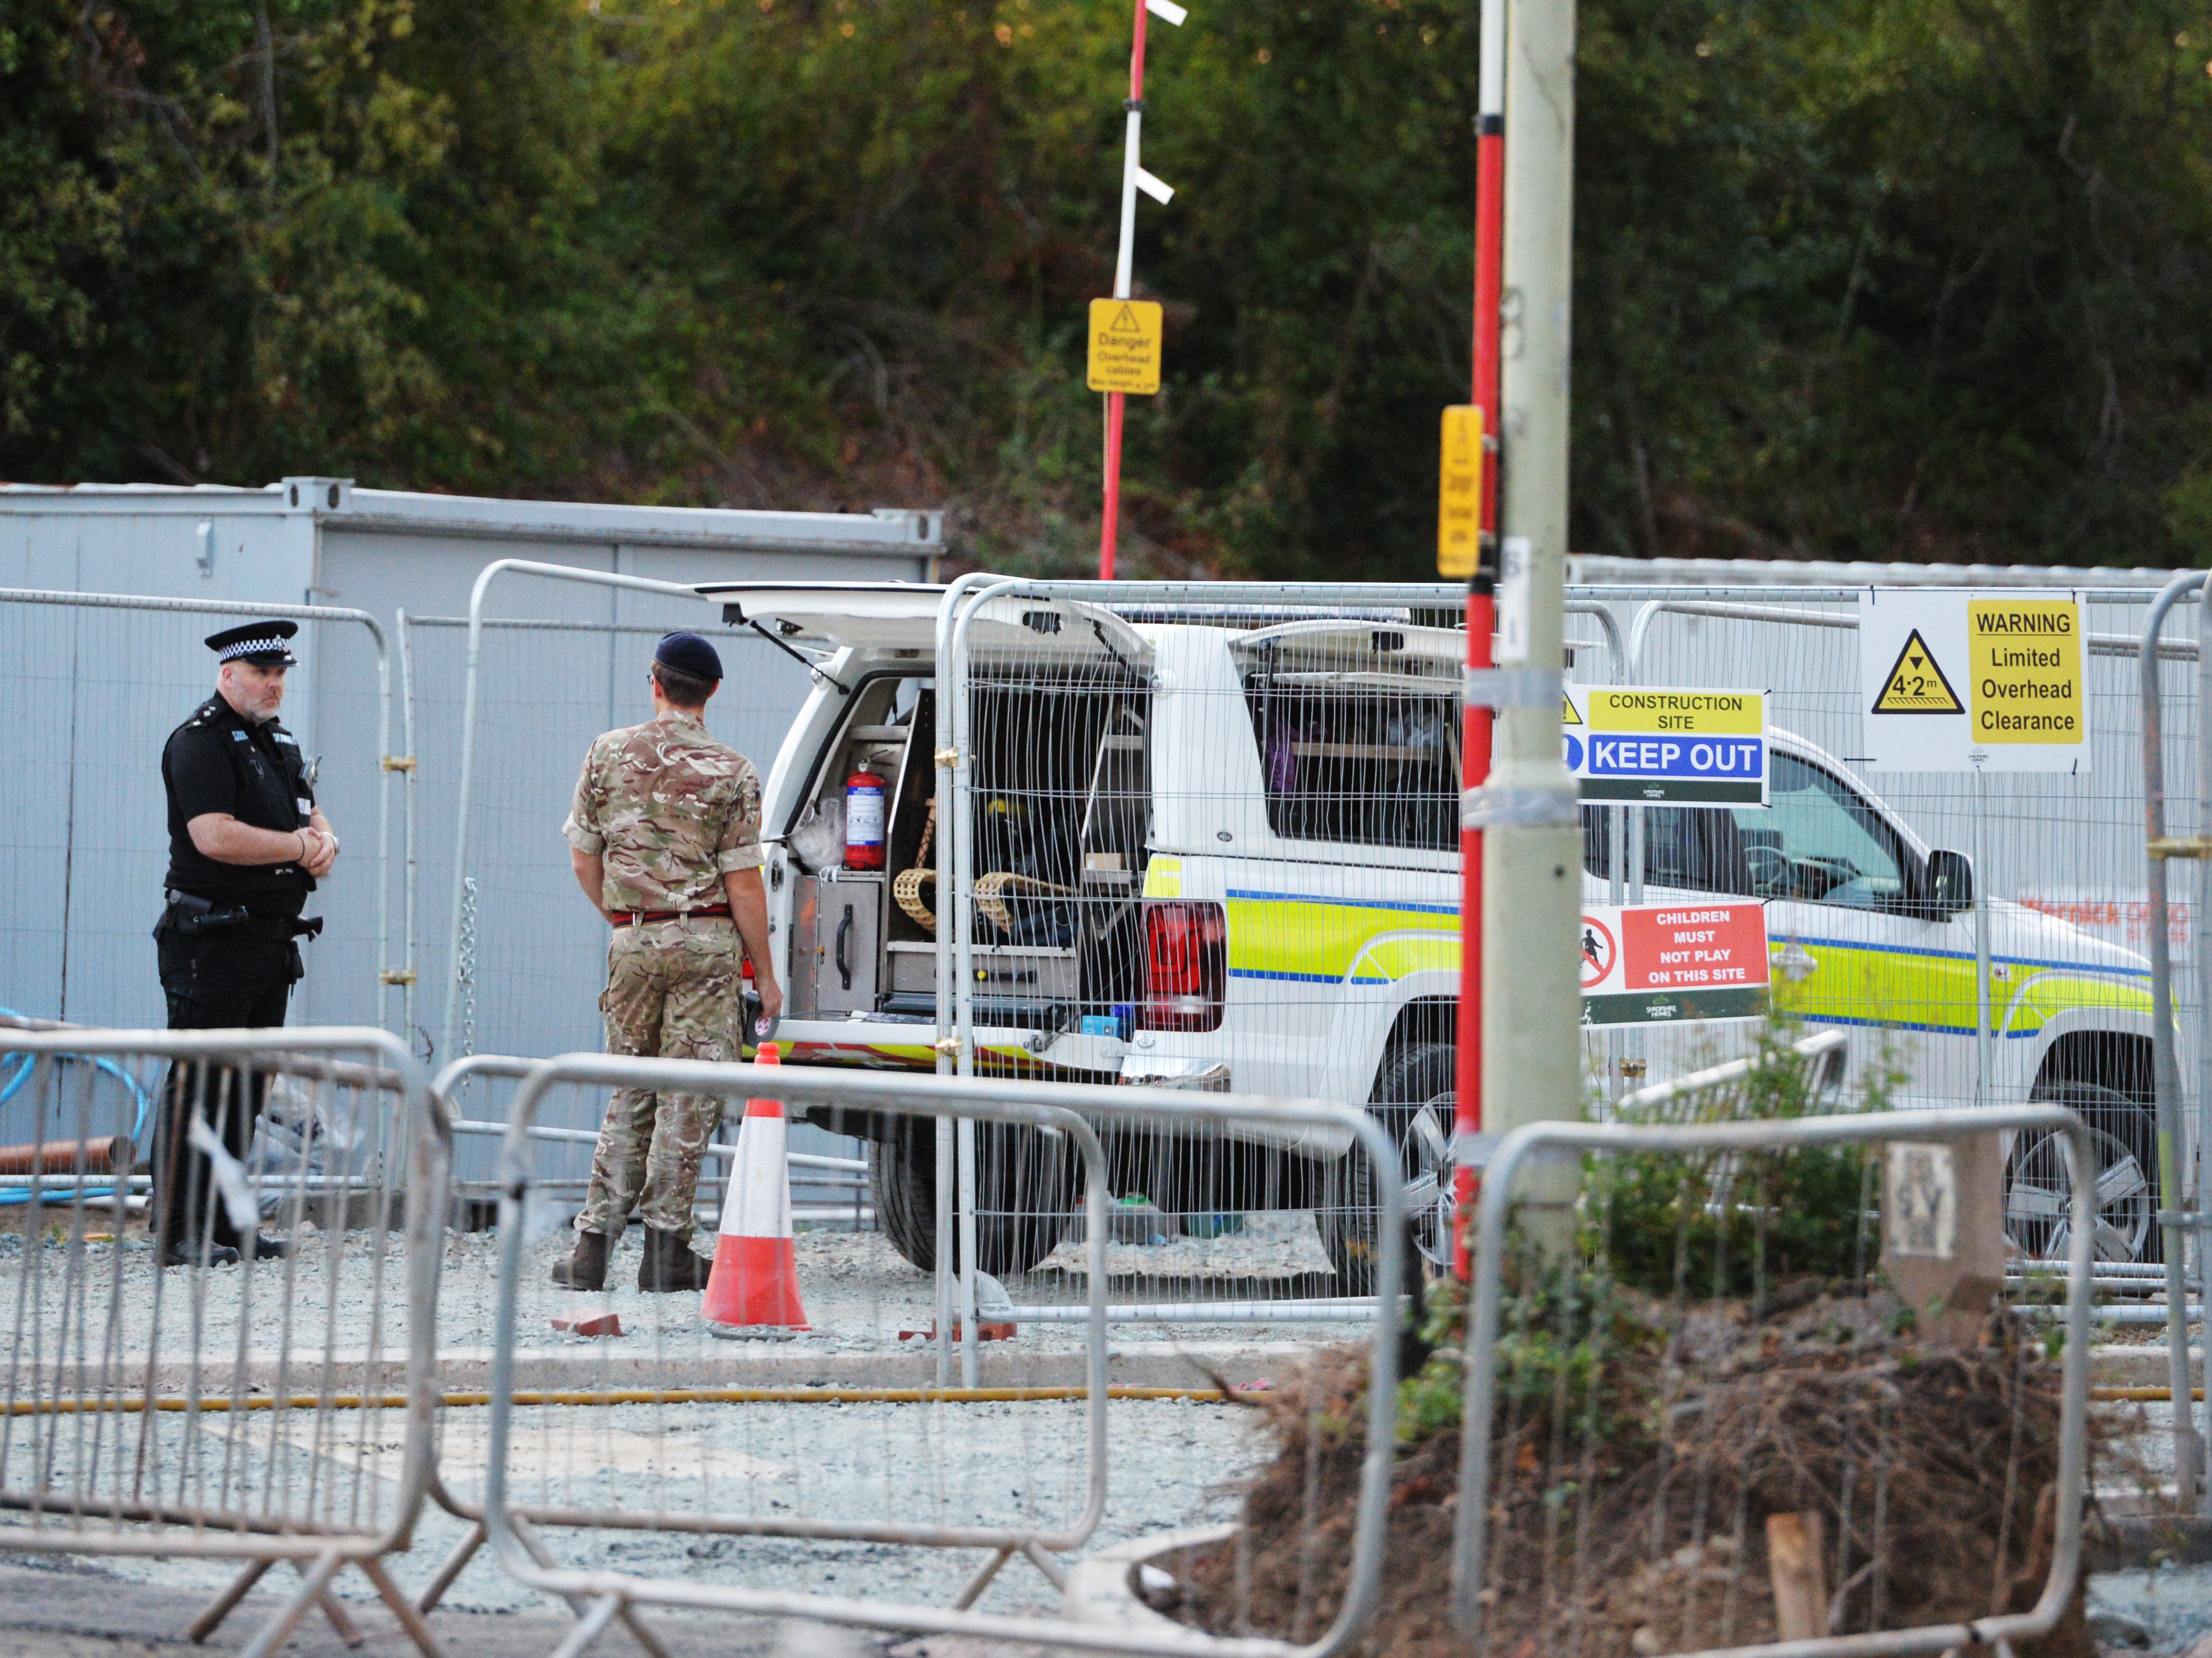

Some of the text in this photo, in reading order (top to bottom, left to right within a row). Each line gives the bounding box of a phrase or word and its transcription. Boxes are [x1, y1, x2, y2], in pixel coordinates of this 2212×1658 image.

[1098, 332, 1151, 349] Danger
[1976, 613, 2071, 633] WARNING
[1992, 648, 2060, 667] Limited
[1982, 679, 2072, 699] Overhead
[1609, 694, 1742, 710] CONSTRUCTION
[1658, 715, 1694, 729] SITE
[1981, 710, 2074, 730] Clearance
[1596, 741, 1757, 771] KEEP OUT
[1656, 910, 1730, 925] CHILDREN
[1674, 930, 1715, 943] MUST
[1660, 949, 1731, 963] NOT PLAY
[1648, 967, 1745, 983] ON THIS SITE
